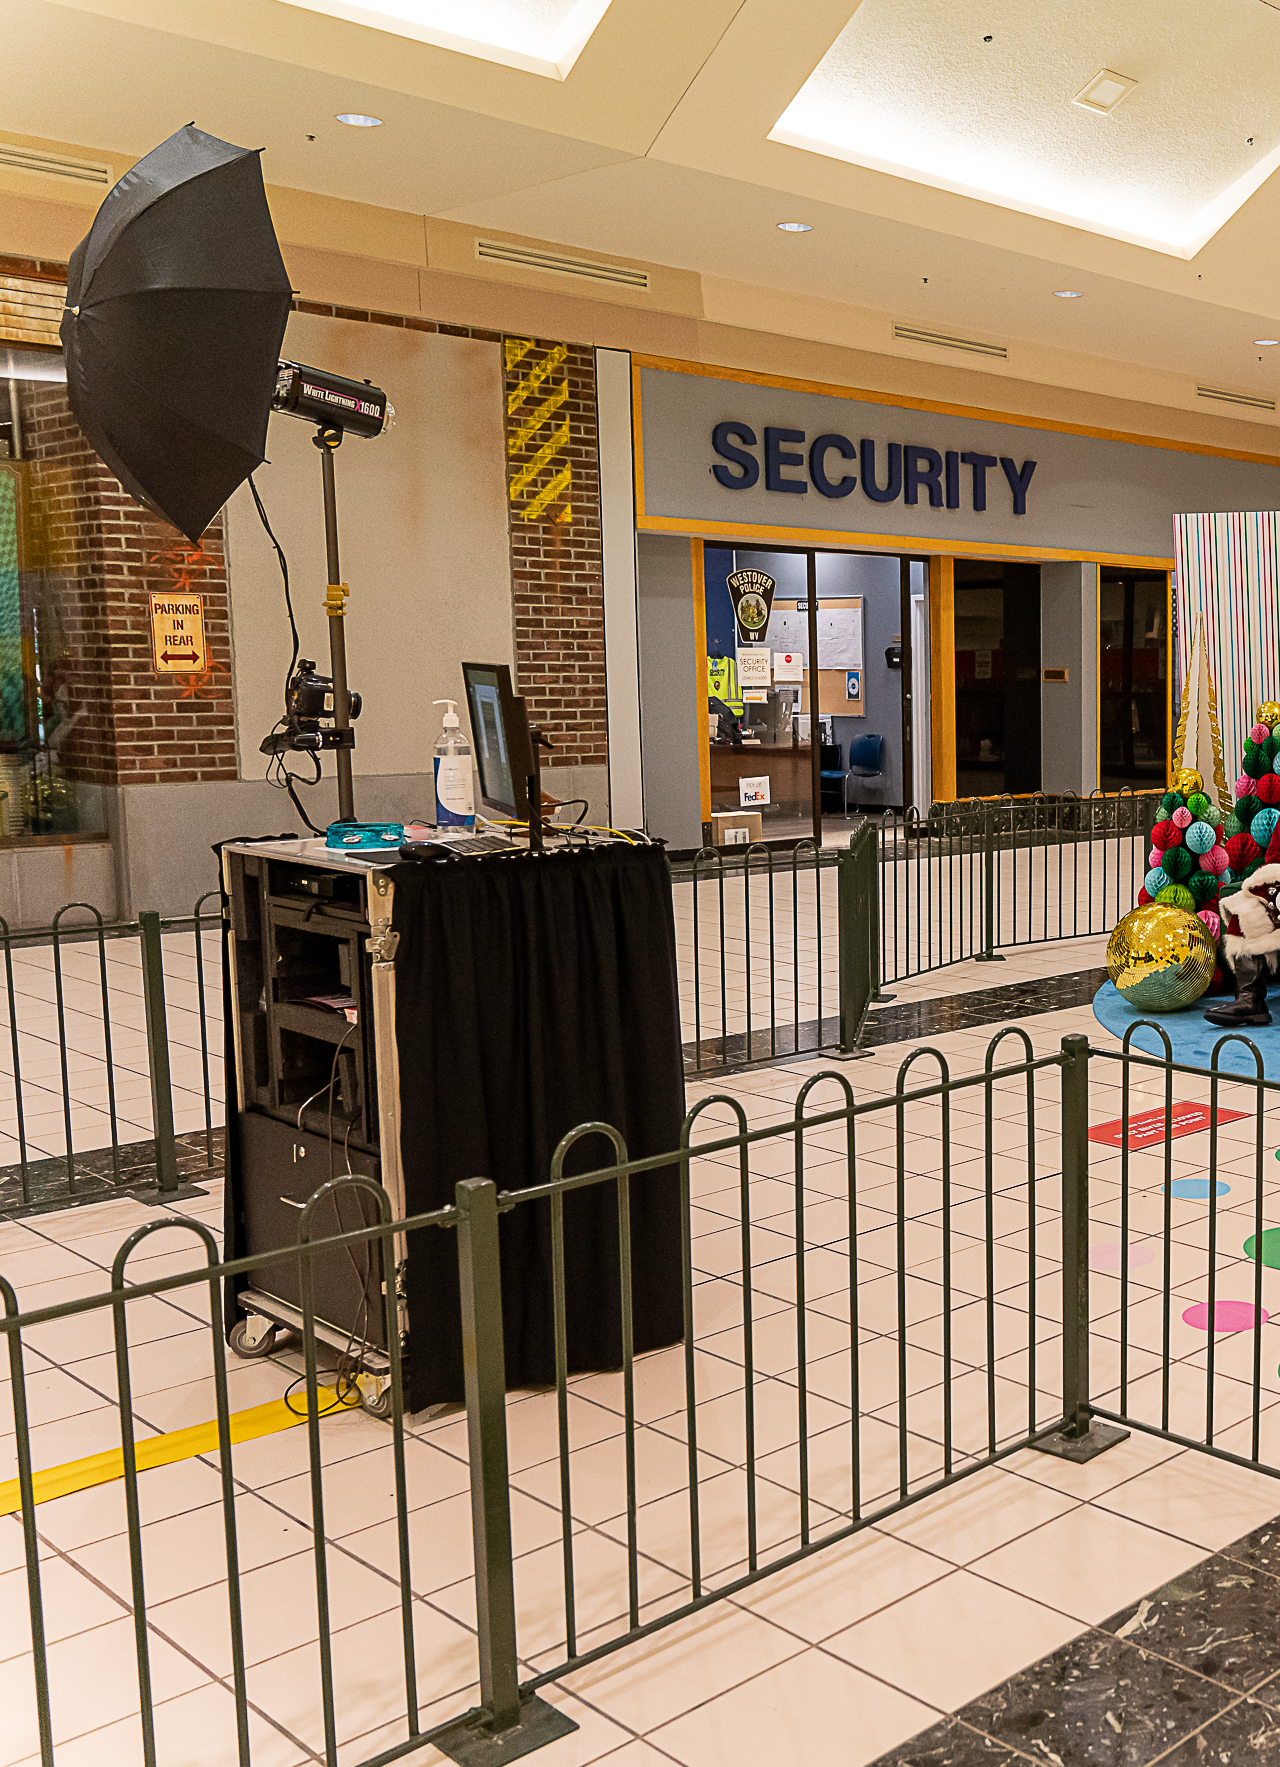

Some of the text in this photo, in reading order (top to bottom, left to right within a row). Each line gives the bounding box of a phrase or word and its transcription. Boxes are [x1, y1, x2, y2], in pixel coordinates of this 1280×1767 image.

[712, 421, 1037, 515] SECURITY
[730, 571, 773, 590] WESTOVER
[739, 583, 765, 596] POLICE
[154, 603, 200, 615] PARKING
[173, 620, 184, 631] IN
[165, 635, 194, 646] REAR
[749, 632, 759, 640] WV
[744, 791, 765, 801] FedEx
